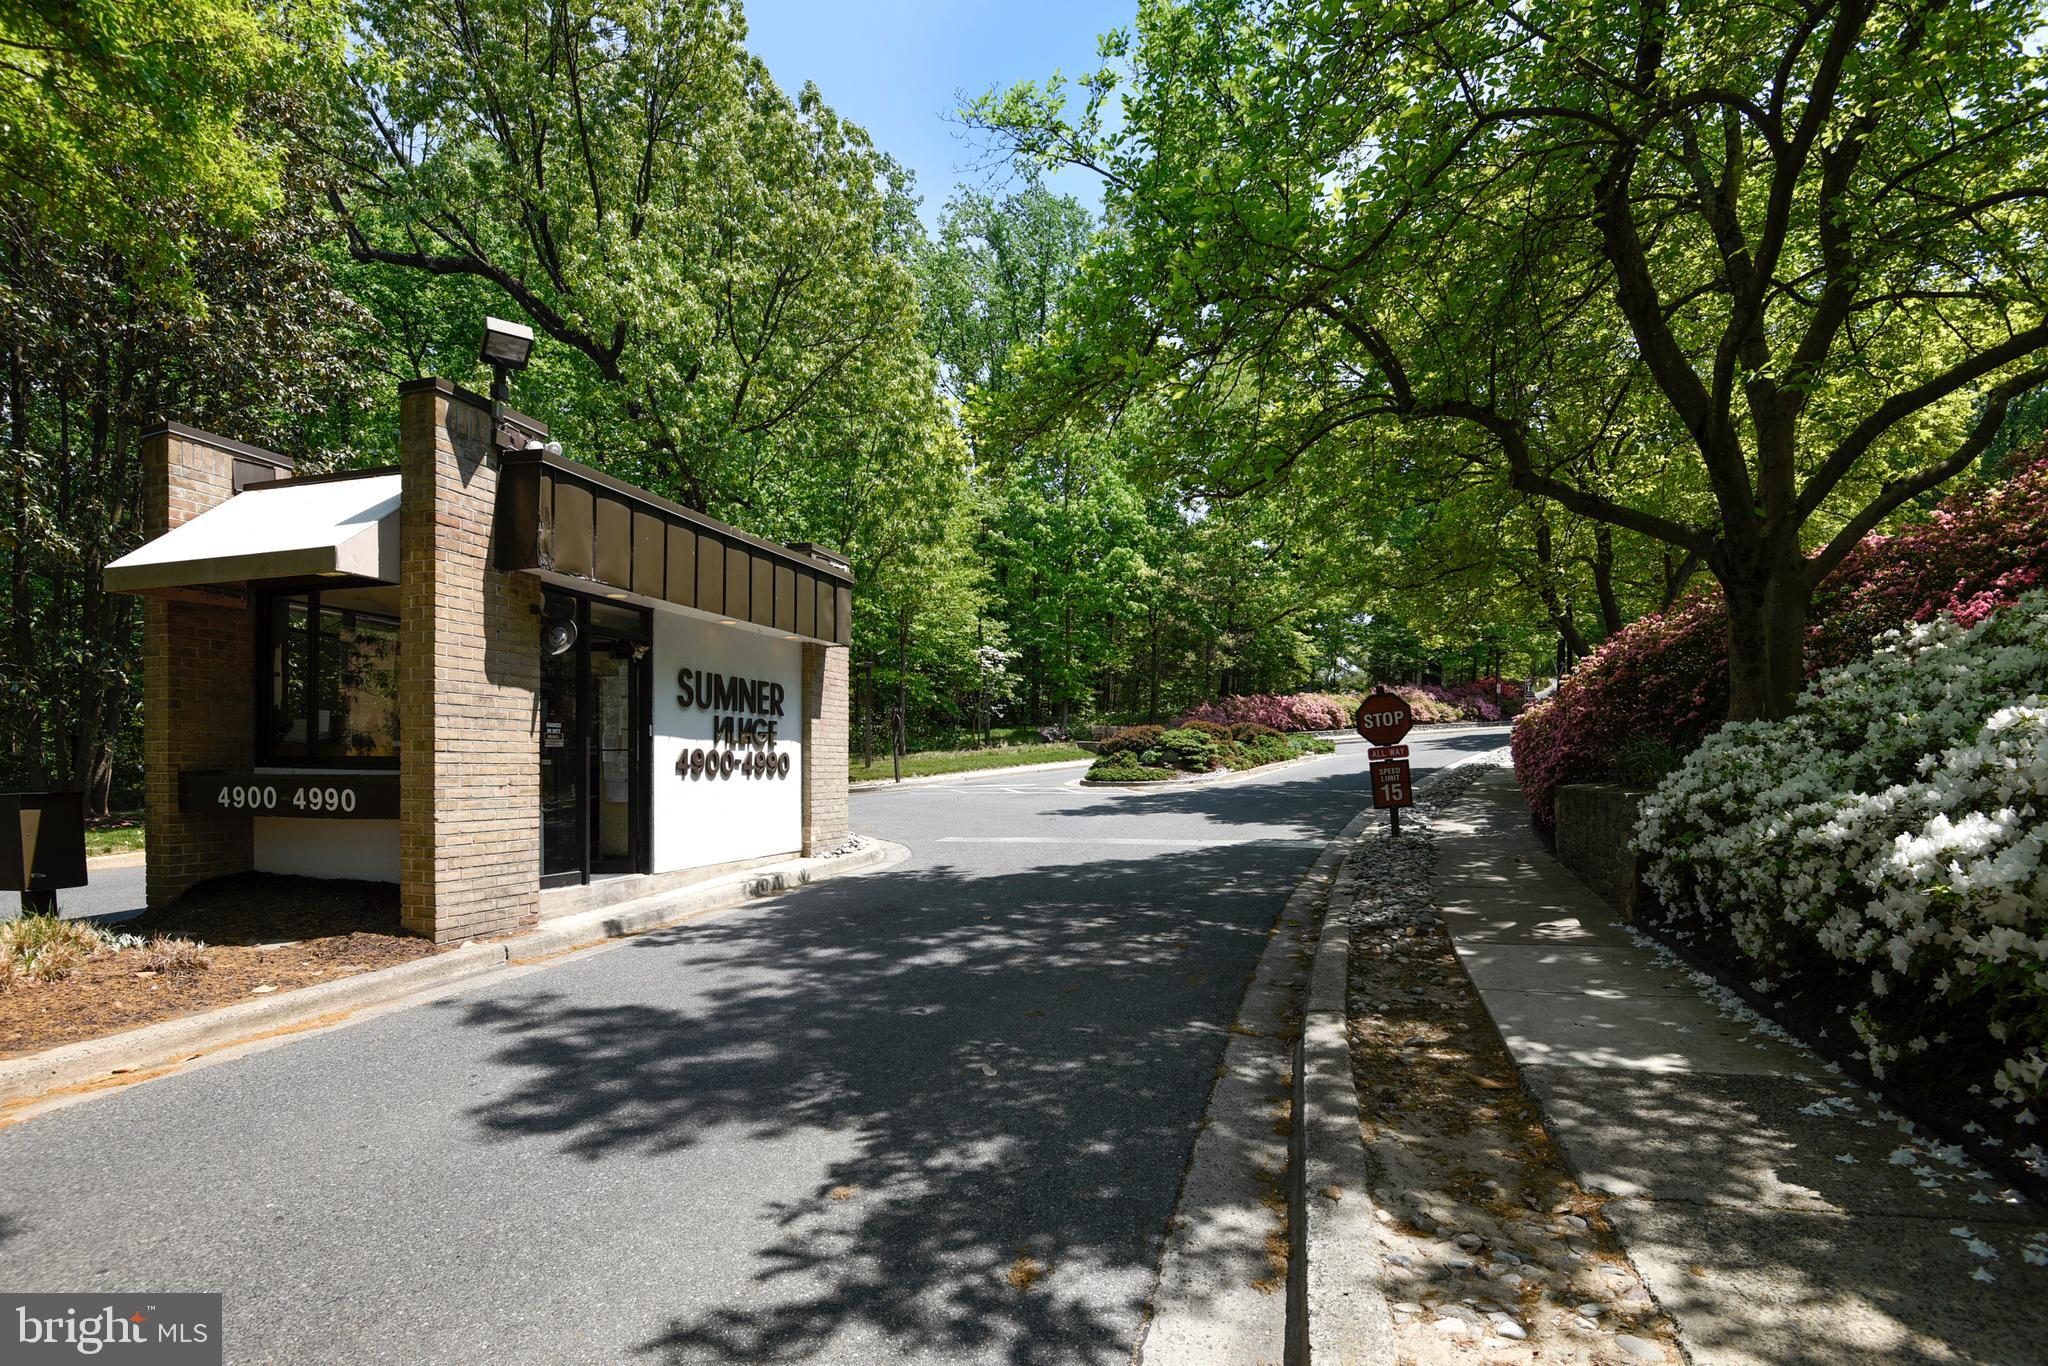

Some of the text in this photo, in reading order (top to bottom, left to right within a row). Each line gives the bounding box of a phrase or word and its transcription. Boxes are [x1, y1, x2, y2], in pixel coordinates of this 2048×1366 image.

[677, 668, 784, 717] SUMNER
[1363, 711, 1404, 729] STOP
[1371, 747, 1405, 759] ALL WAY
[676, 748, 790, 777] 4900-4990
[1379, 767, 1401, 775] SPEED
[1381, 774, 1400, 782] LIMIT
[217, 786, 356, 813] 4900 4990
[1381, 783, 1403, 801] 15
